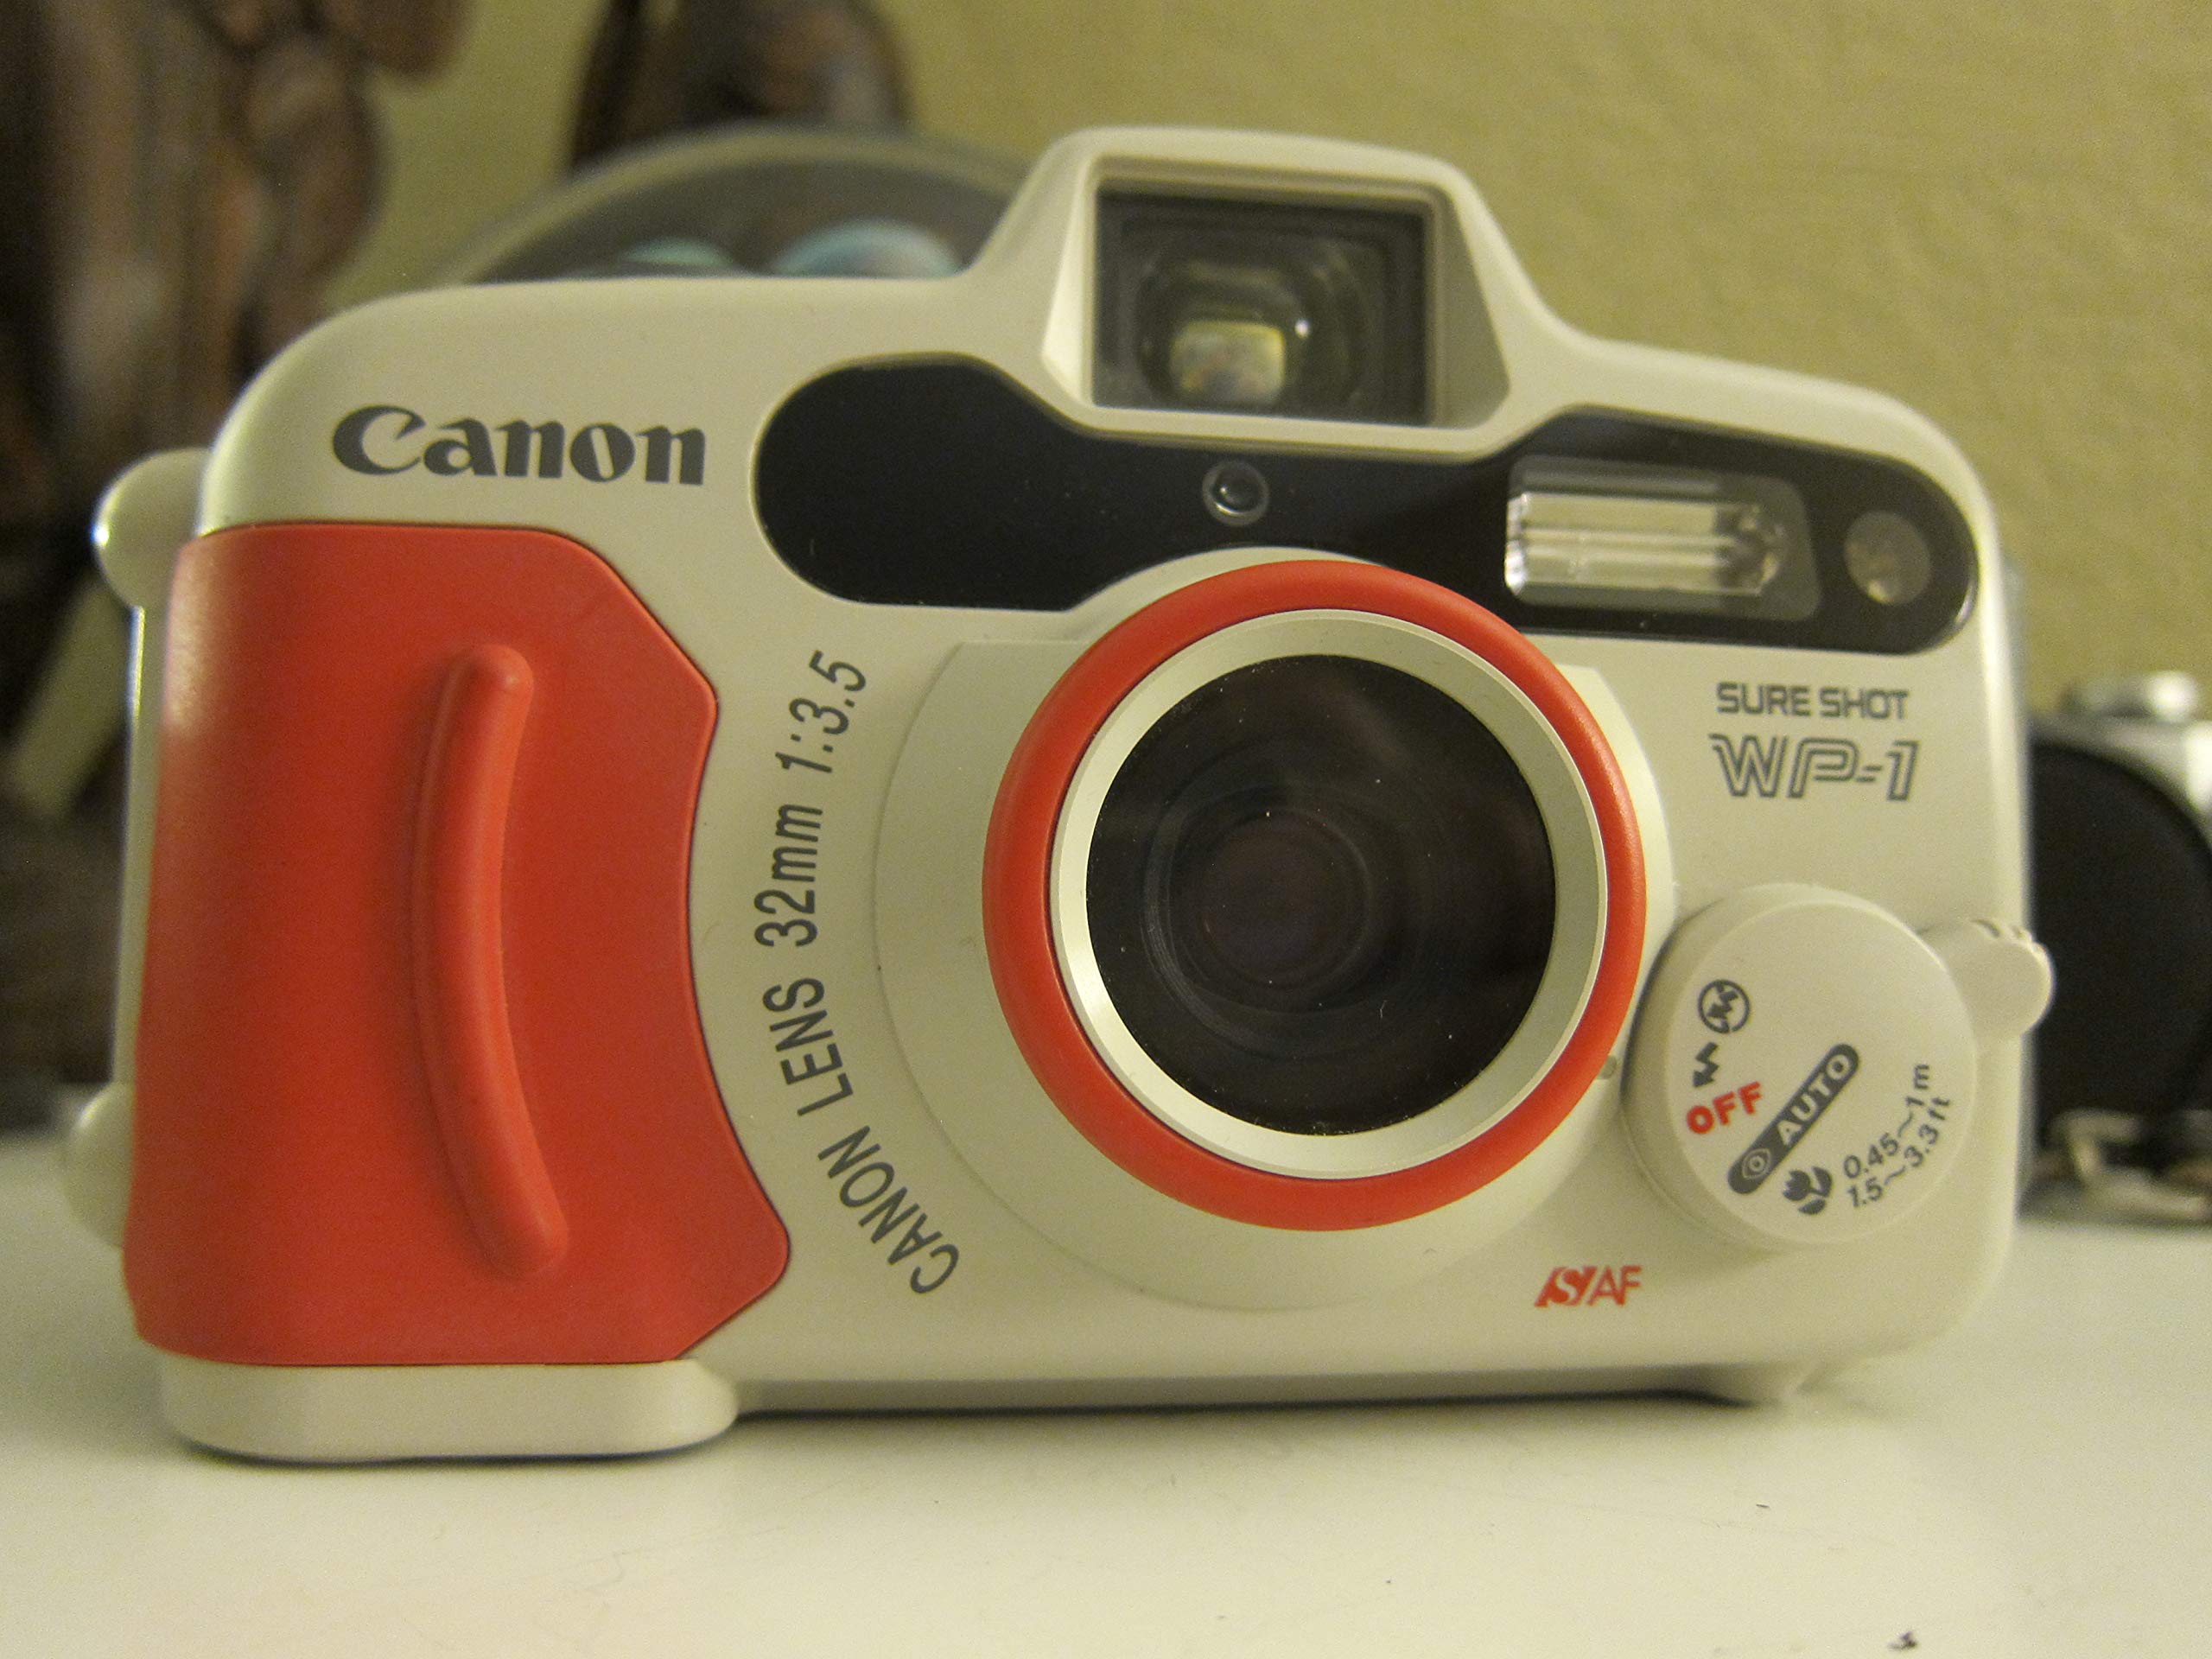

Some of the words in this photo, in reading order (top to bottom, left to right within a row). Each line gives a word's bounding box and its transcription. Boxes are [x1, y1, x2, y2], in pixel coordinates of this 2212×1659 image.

[332, 404, 706, 485] Canon
[775, 650, 866, 772] 1:3.5
[1716, 682, 1811, 716] SURE
[1819, 687, 1909, 719] SHOT
[1708, 734, 1919, 801] WP-1
[753, 804, 823, 947] 32mm
[762, 977, 854, 1116] LENS
[1686, 1081, 1763, 1134] OFF
[1775, 1052, 1852, 1146] AUTO
[817, 1125, 959, 1294] CANON
